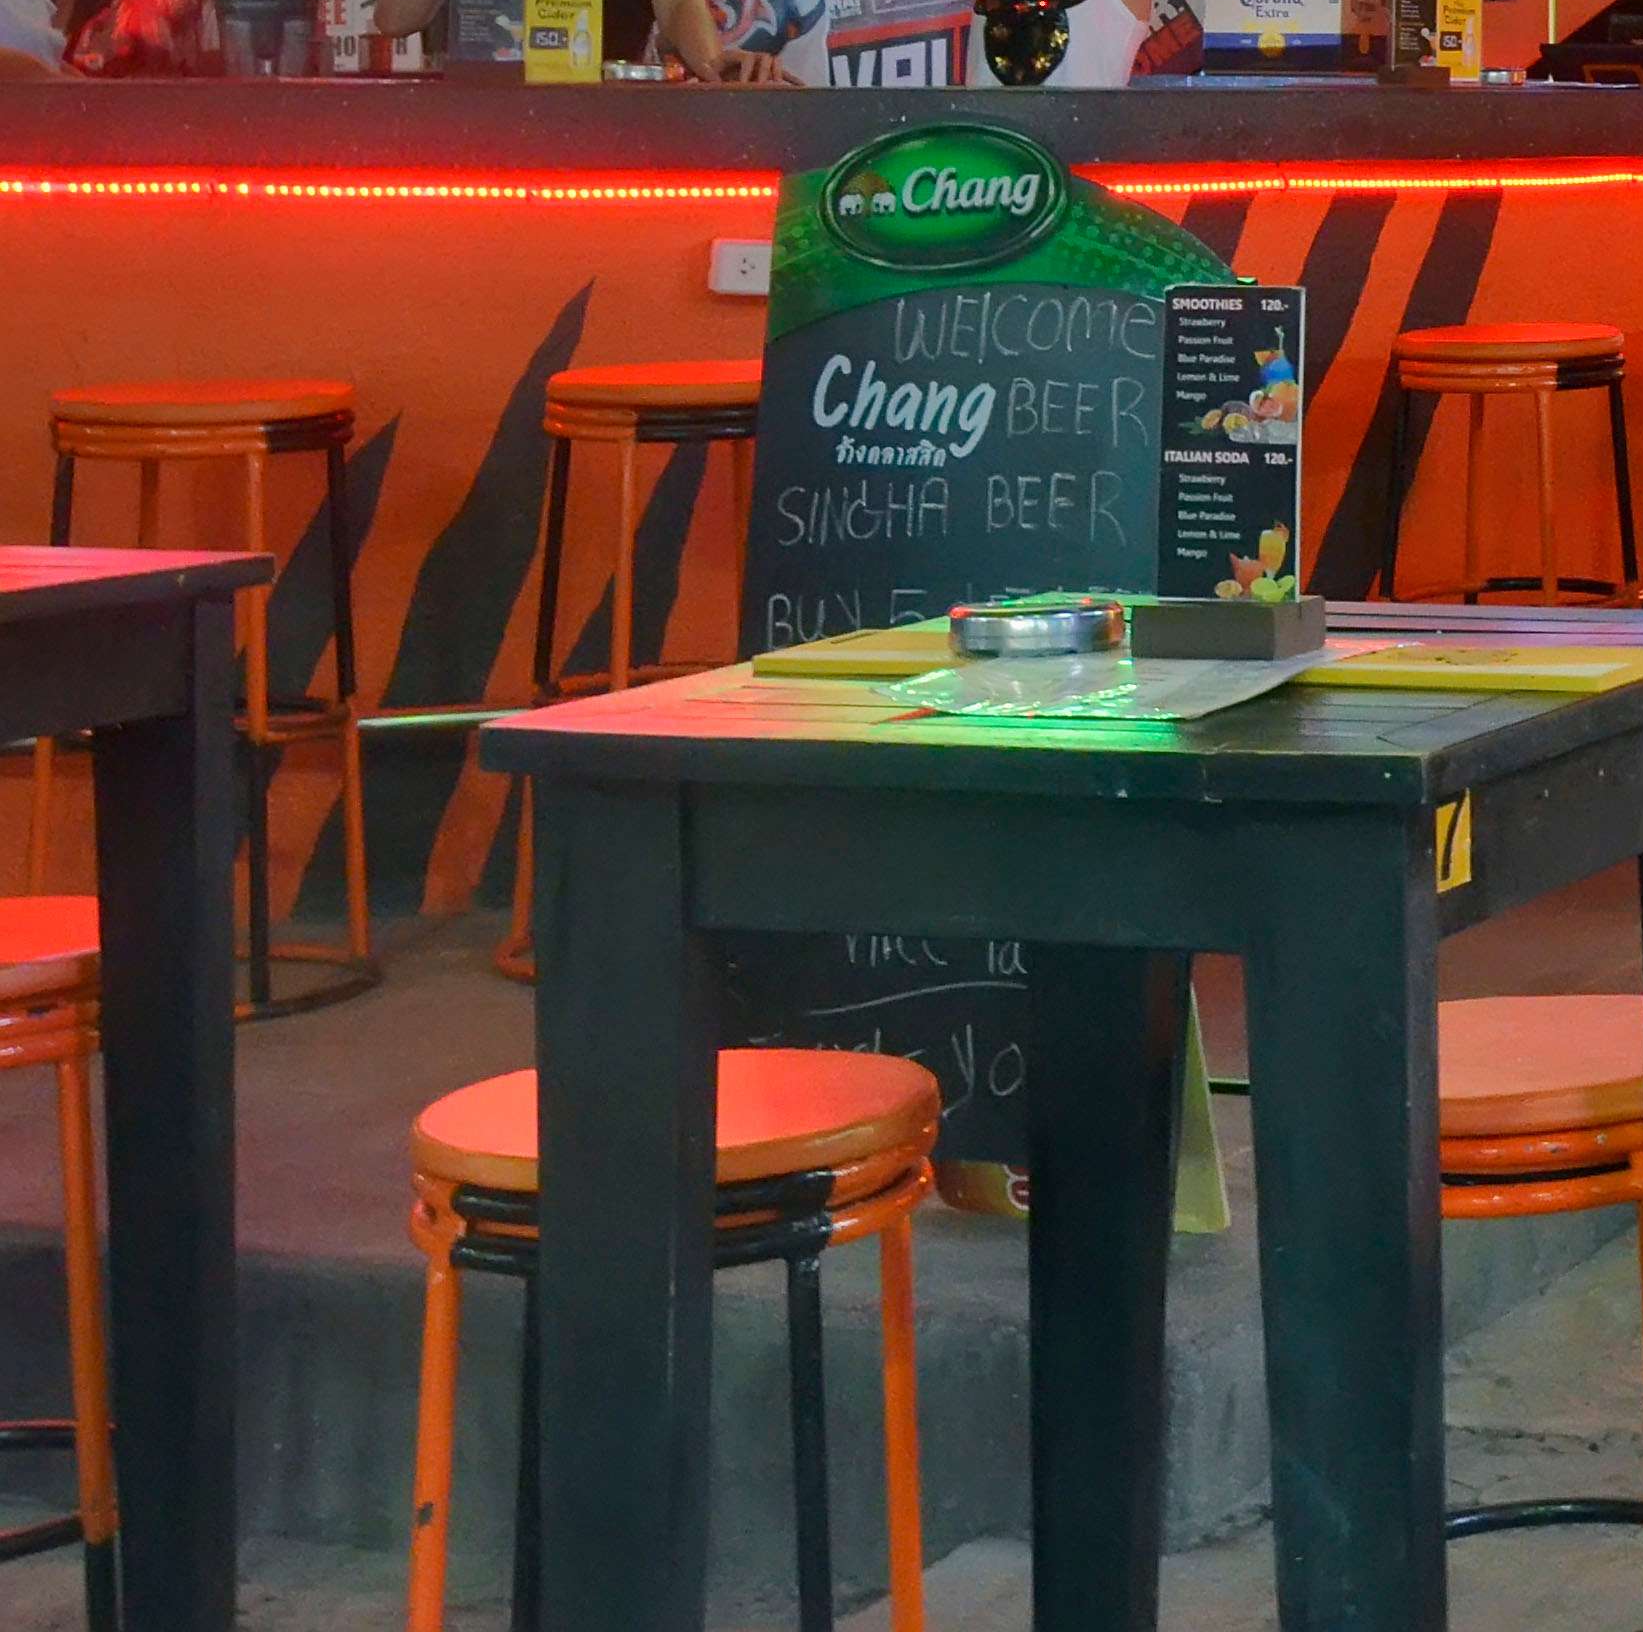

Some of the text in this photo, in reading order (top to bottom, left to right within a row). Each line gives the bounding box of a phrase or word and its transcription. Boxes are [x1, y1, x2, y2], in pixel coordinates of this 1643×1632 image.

[537, 8, 575, 20] Cider
[1255, 5, 1290, 19] Extra
[902, 167, 1041, 215] Chang
[1171, 297, 1290, 312] SMOOTHIES 120.-
[1178, 316, 1227, 329] Strawberry
[1177, 334, 1234, 346] Passion Fruit
[1177, 353, 1236, 365] Blue Paradise
[1176, 371, 1207, 384] Lemon
[1218, 371, 1241, 384] Lime
[1175, 390, 1207, 404] Mango
[812, 353, 1148, 459] Chang BEER
[1164, 450, 1294, 466] ITALIAN SODA 120.-
[1178, 473, 1227, 487] Strawberry
[1177, 491, 1234, 504] Passion Fruit
[776, 469, 1128, 547] SINGHA BEER
[1177, 510, 1236, 522] Blue Paradise
[1177, 529, 1207, 541] Lemon
[1218, 529, 1241, 541] Lime
[1176, 547, 1208, 560] Mango
